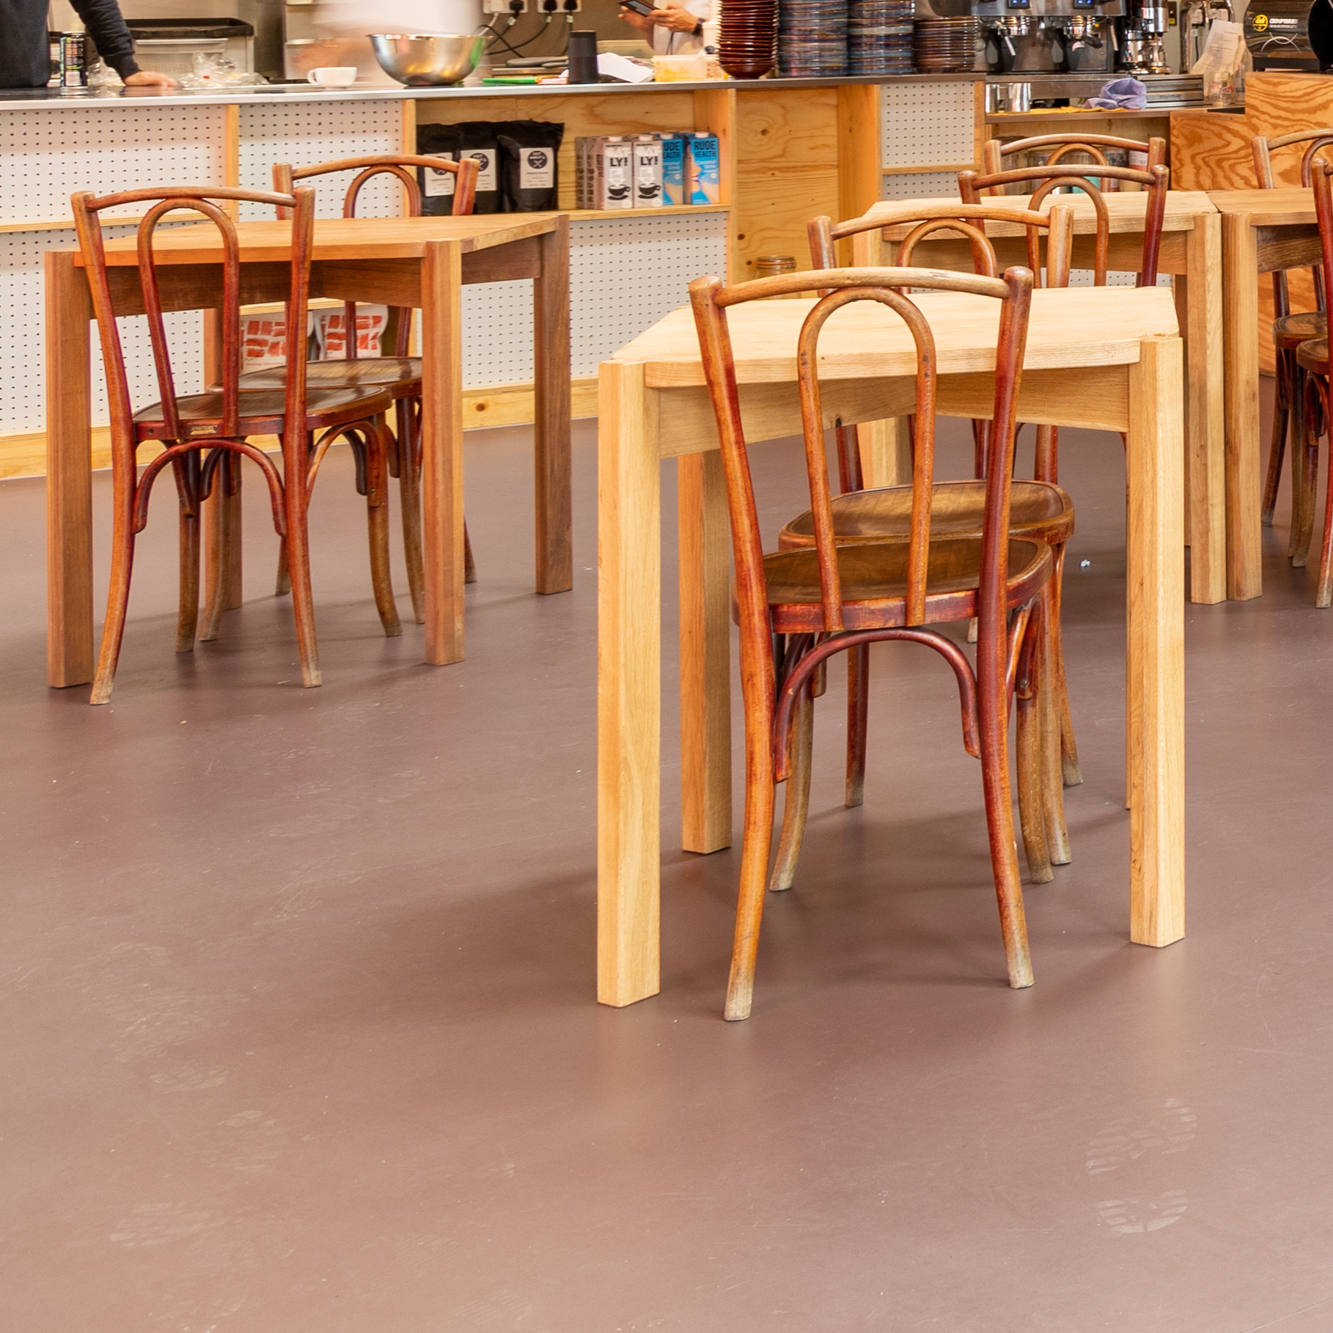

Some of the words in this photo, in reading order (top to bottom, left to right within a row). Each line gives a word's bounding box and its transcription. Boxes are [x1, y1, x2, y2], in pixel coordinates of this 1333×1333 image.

[663, 142, 680, 151] UDE
[693, 141, 716, 150] RUDE
[610, 157, 628, 167] LY!
[640, 156, 658, 166] LY!
